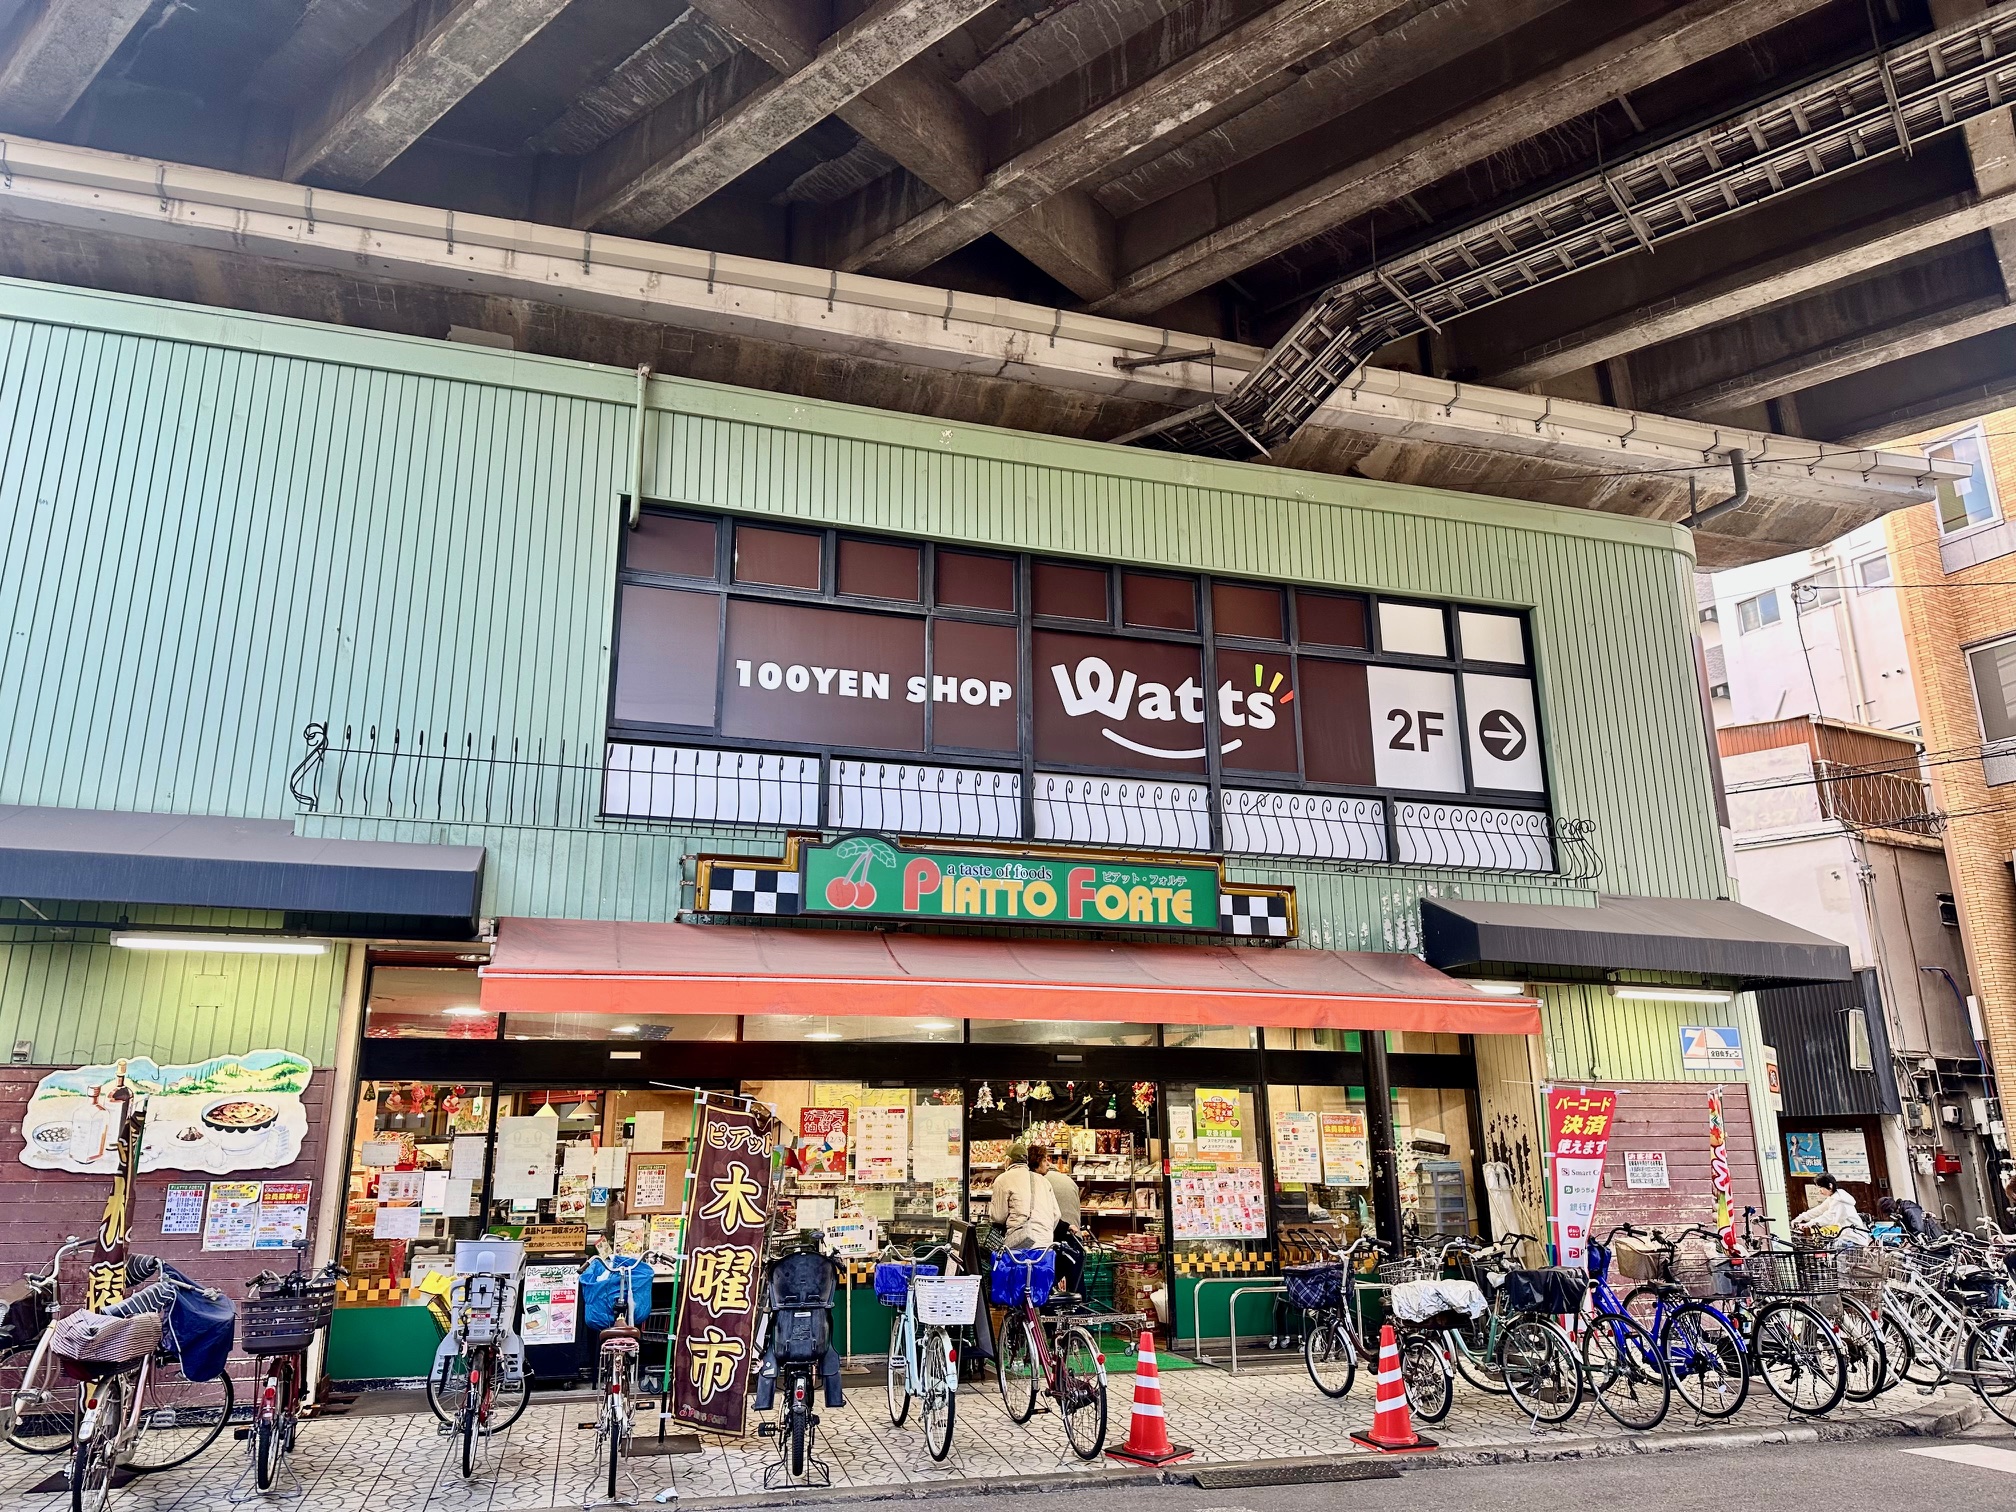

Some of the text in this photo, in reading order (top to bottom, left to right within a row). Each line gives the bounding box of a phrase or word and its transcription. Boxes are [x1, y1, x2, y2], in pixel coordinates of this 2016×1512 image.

[735, 658, 1013, 707] 100YEN SHOP
[1050, 656, 1277, 730] Watts
[1386, 708, 1444, 753] 2F
[946, 862, 1053, 880] a taste of foods
[902, 856, 1193, 925] PIATTO FORTE
[1555, 1096, 1613, 1112] バーコード
[803, 1109, 845, 1121] ガラガラ
[1560, 1114, 1608, 1136] 決済
[628, 1125, 634, 1136] 1
[803, 1120, 844, 1134] 抽選会
[706, 1120, 773, 1158] ピアット
[1557, 1138, 1607, 1156] 使えます
[1571, 1168, 1591, 1176] Smart
[686, 1160, 767, 1406] 木曜市
